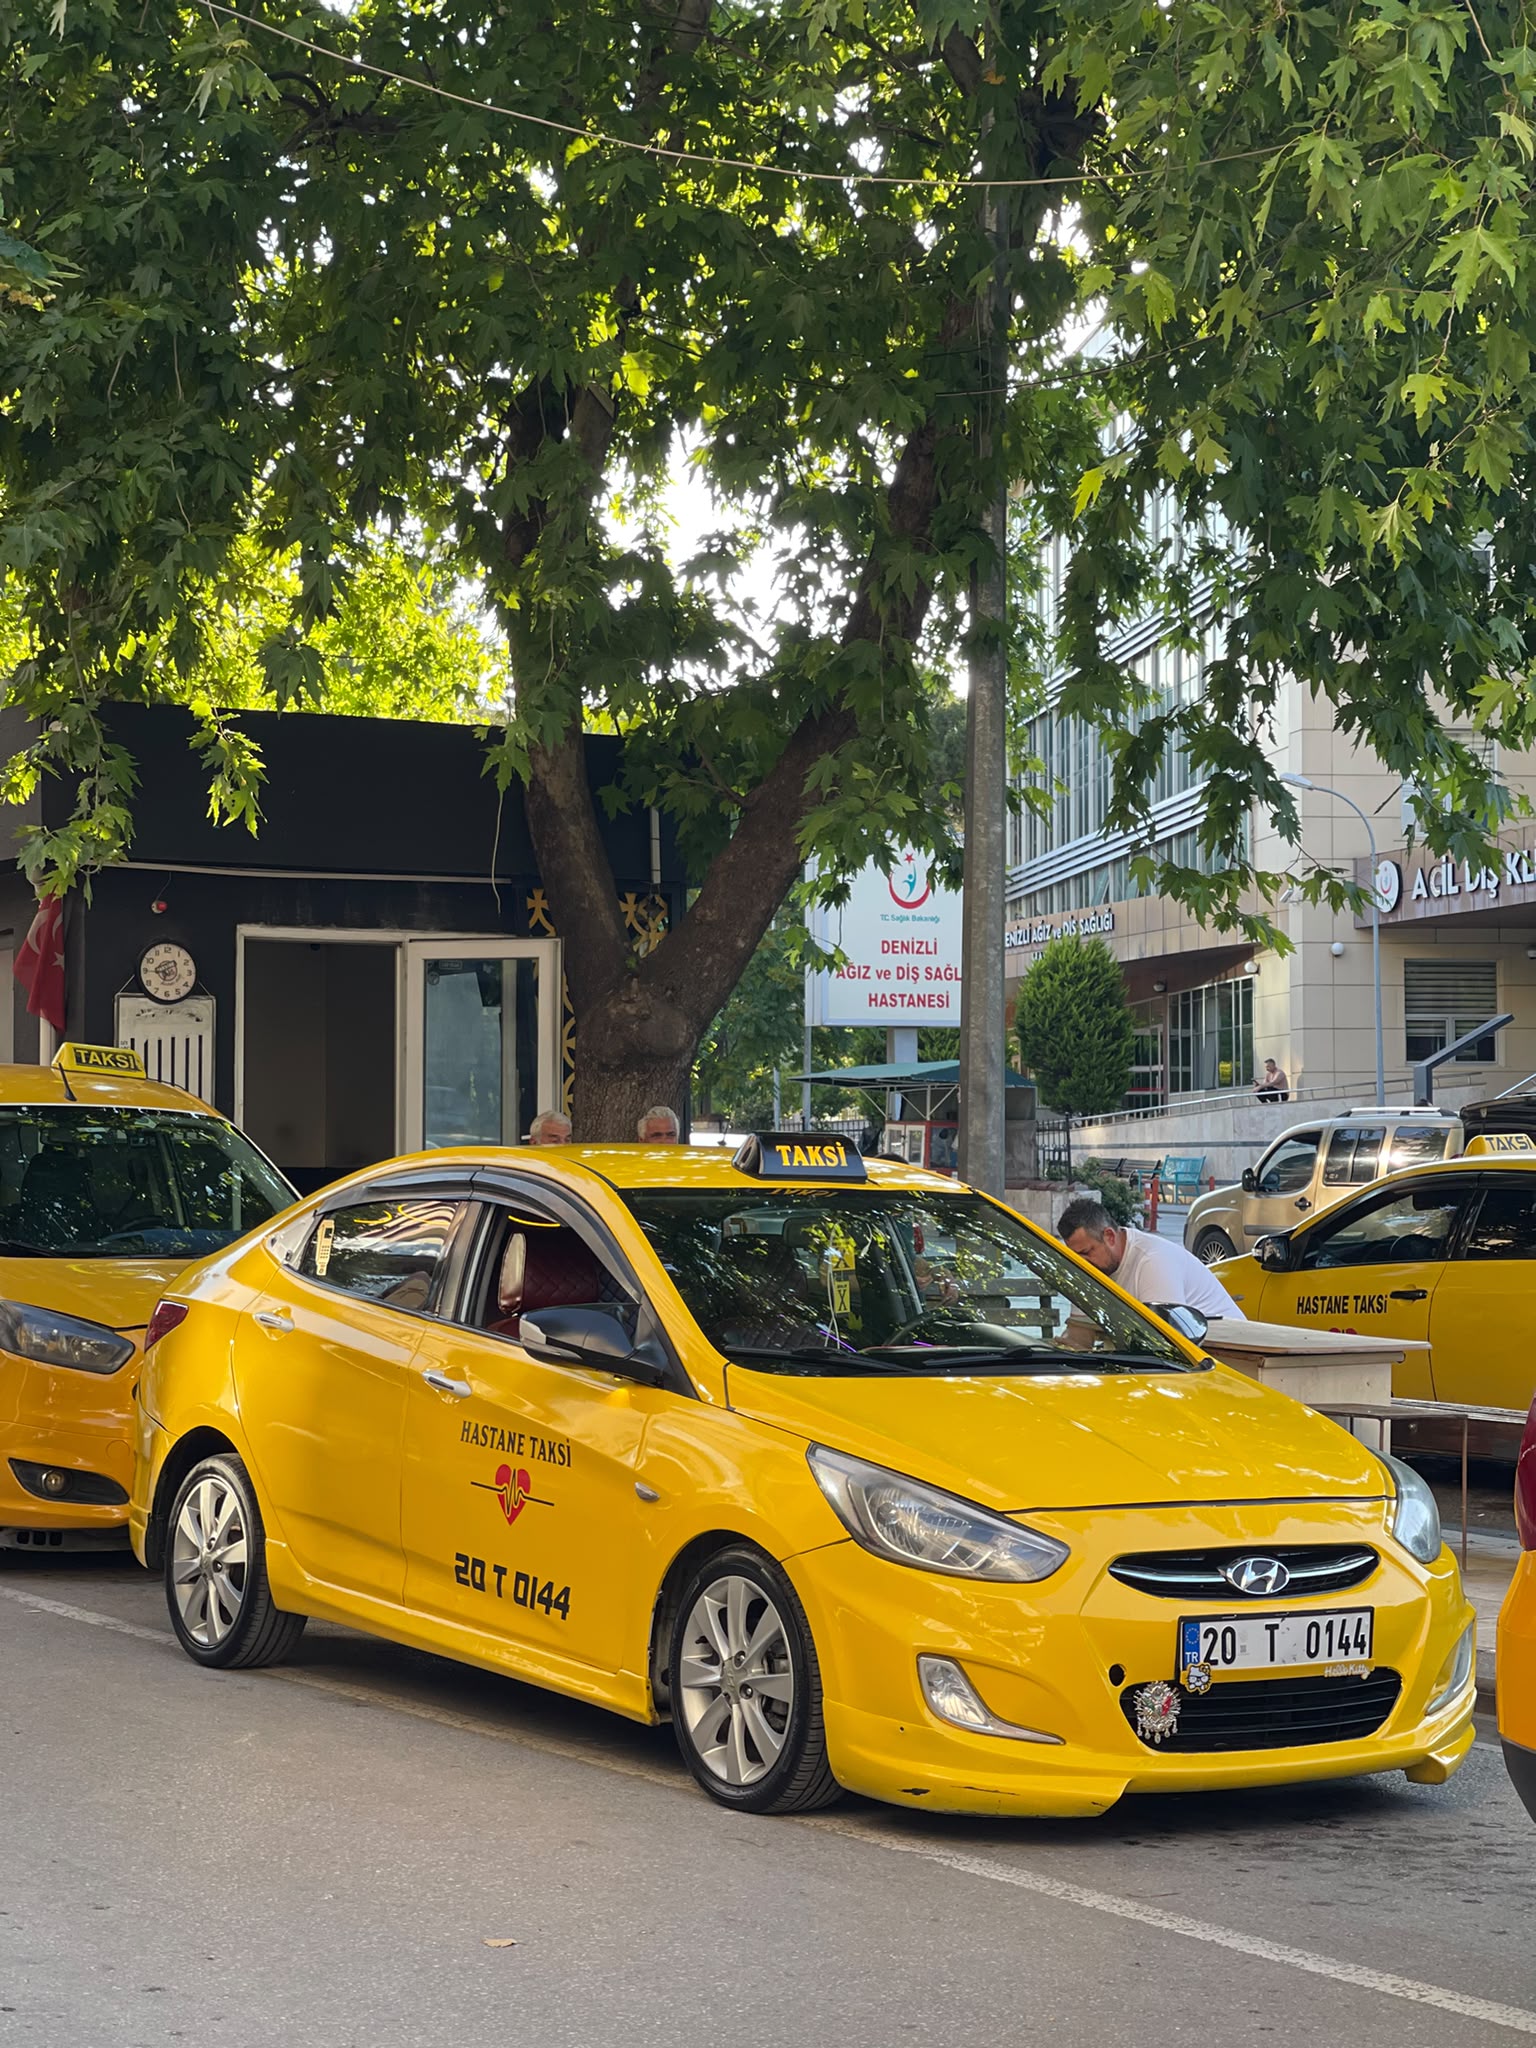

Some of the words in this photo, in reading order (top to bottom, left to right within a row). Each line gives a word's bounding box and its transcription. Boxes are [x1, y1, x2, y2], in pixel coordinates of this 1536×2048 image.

[1506, 849, 1536, 886] KL
[881, 937, 938, 956] DENİZLİ
[1004, 922, 1032, 948] ENİZLİ
[836, 961, 872, 980] AĞIZ
[875, 968, 892, 980] ve
[896, 963, 920, 984] DİŞ
[924, 964, 962, 982] SAĞL
[868, 991, 950, 1009] HASTANESİ
[775, 1141, 848, 1167] TAKSİ
[1296, 1295, 1350, 1315] HASTANE
[460, 1420, 526, 1456] HASTANE
[529, 1436, 572, 1468] TAKSİ
[454, 1552, 487, 1593] 20
[493, 1564, 508, 1598] T
[513, 1570, 571, 1621] 0144
[1203, 1626, 1237, 1666] 20
[1264, 1623, 1280, 1662] T
[1306, 1617, 1367, 1659] 0144
[1184, 1651, 1199, 1663] TR
